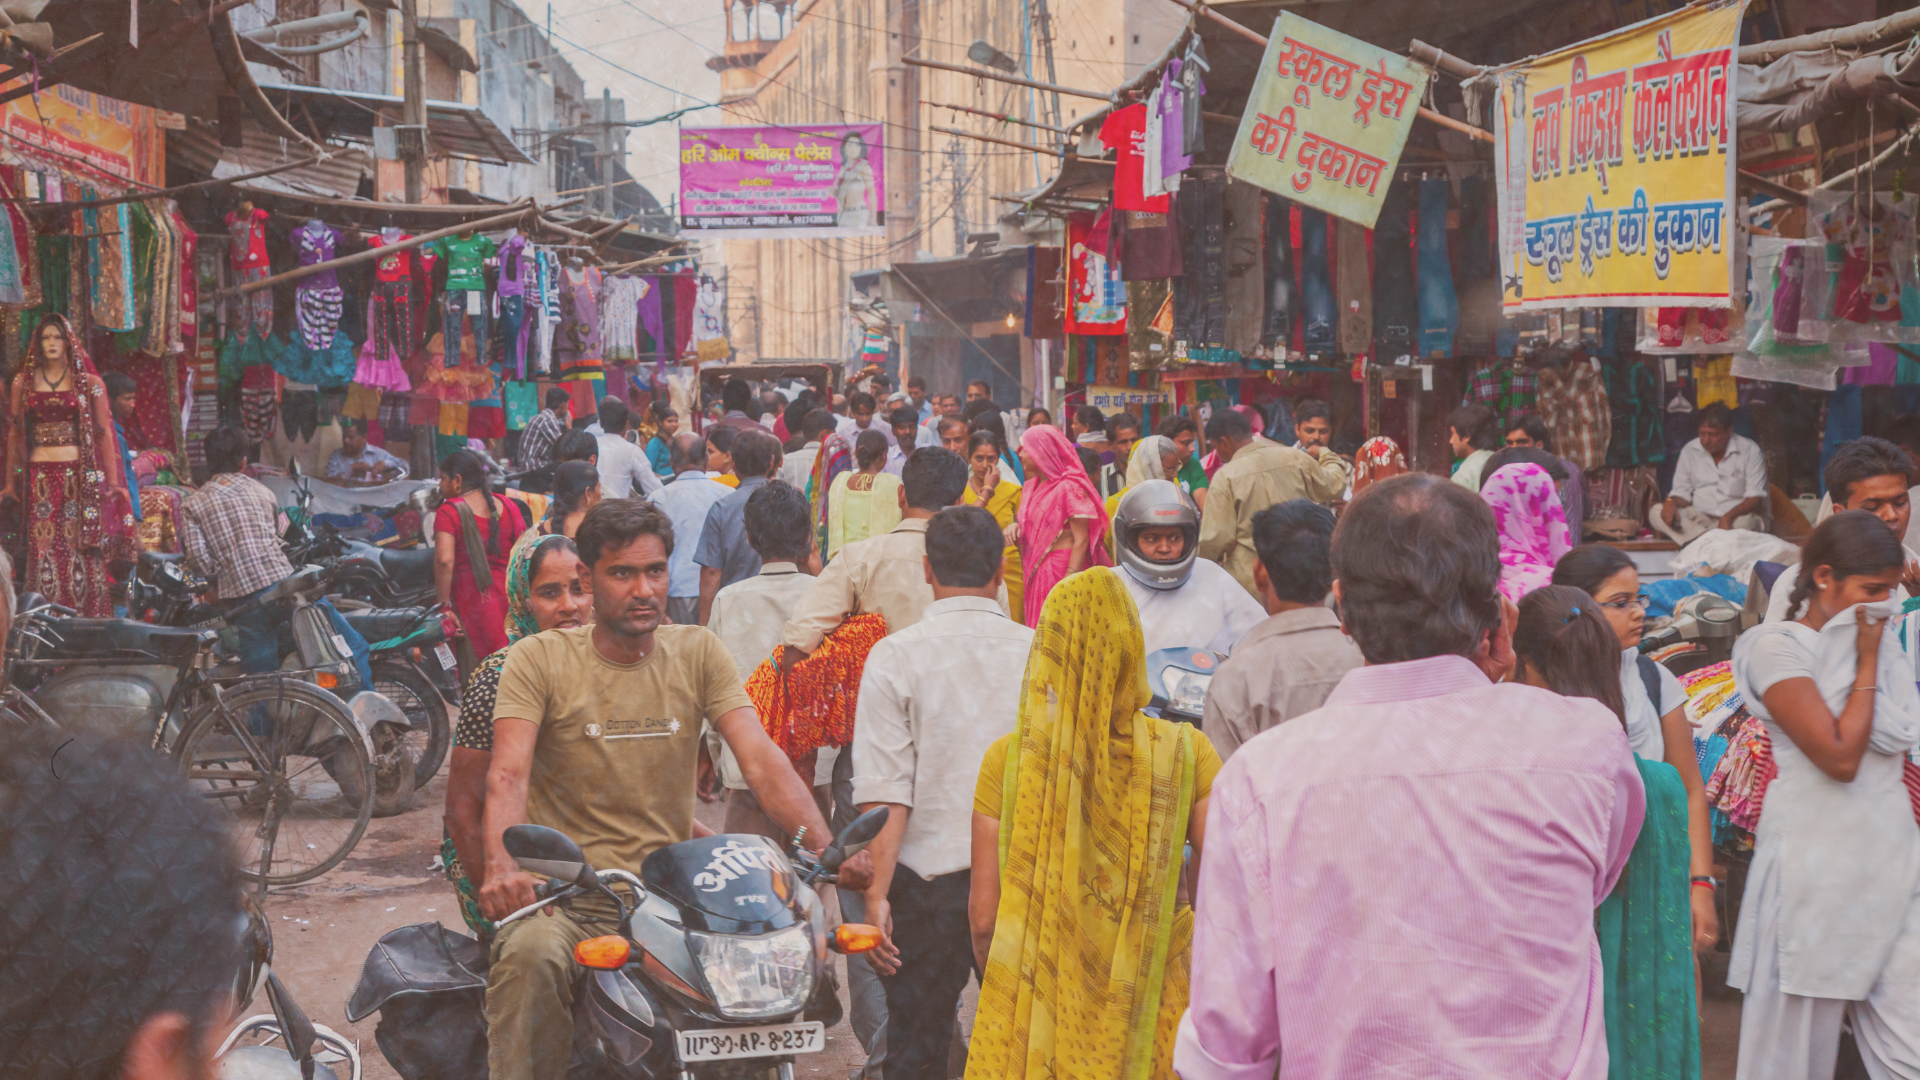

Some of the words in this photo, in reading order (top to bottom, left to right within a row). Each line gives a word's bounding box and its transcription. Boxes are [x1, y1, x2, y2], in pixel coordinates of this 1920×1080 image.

[1278, 36, 1361, 108] स्कूल
[1354, 57, 1414, 127] ड्रेस
[681, 144, 706, 164] हरि
[709, 144, 740, 162] ओम
[744, 143, 791, 161] क्वीन्स
[1250, 105, 1297, 161] की
[1291, 131, 1388, 195] दुकान
[1530, 85, 1565, 181] लव
[1525, 213, 1578, 283] स्कूल
[1617, 186, 1649, 256] की
[1653, 199, 1726, 280] दुकान
[1093, 392, 1110, 408] हमारे
[733, 893, 769, 906] TVS
